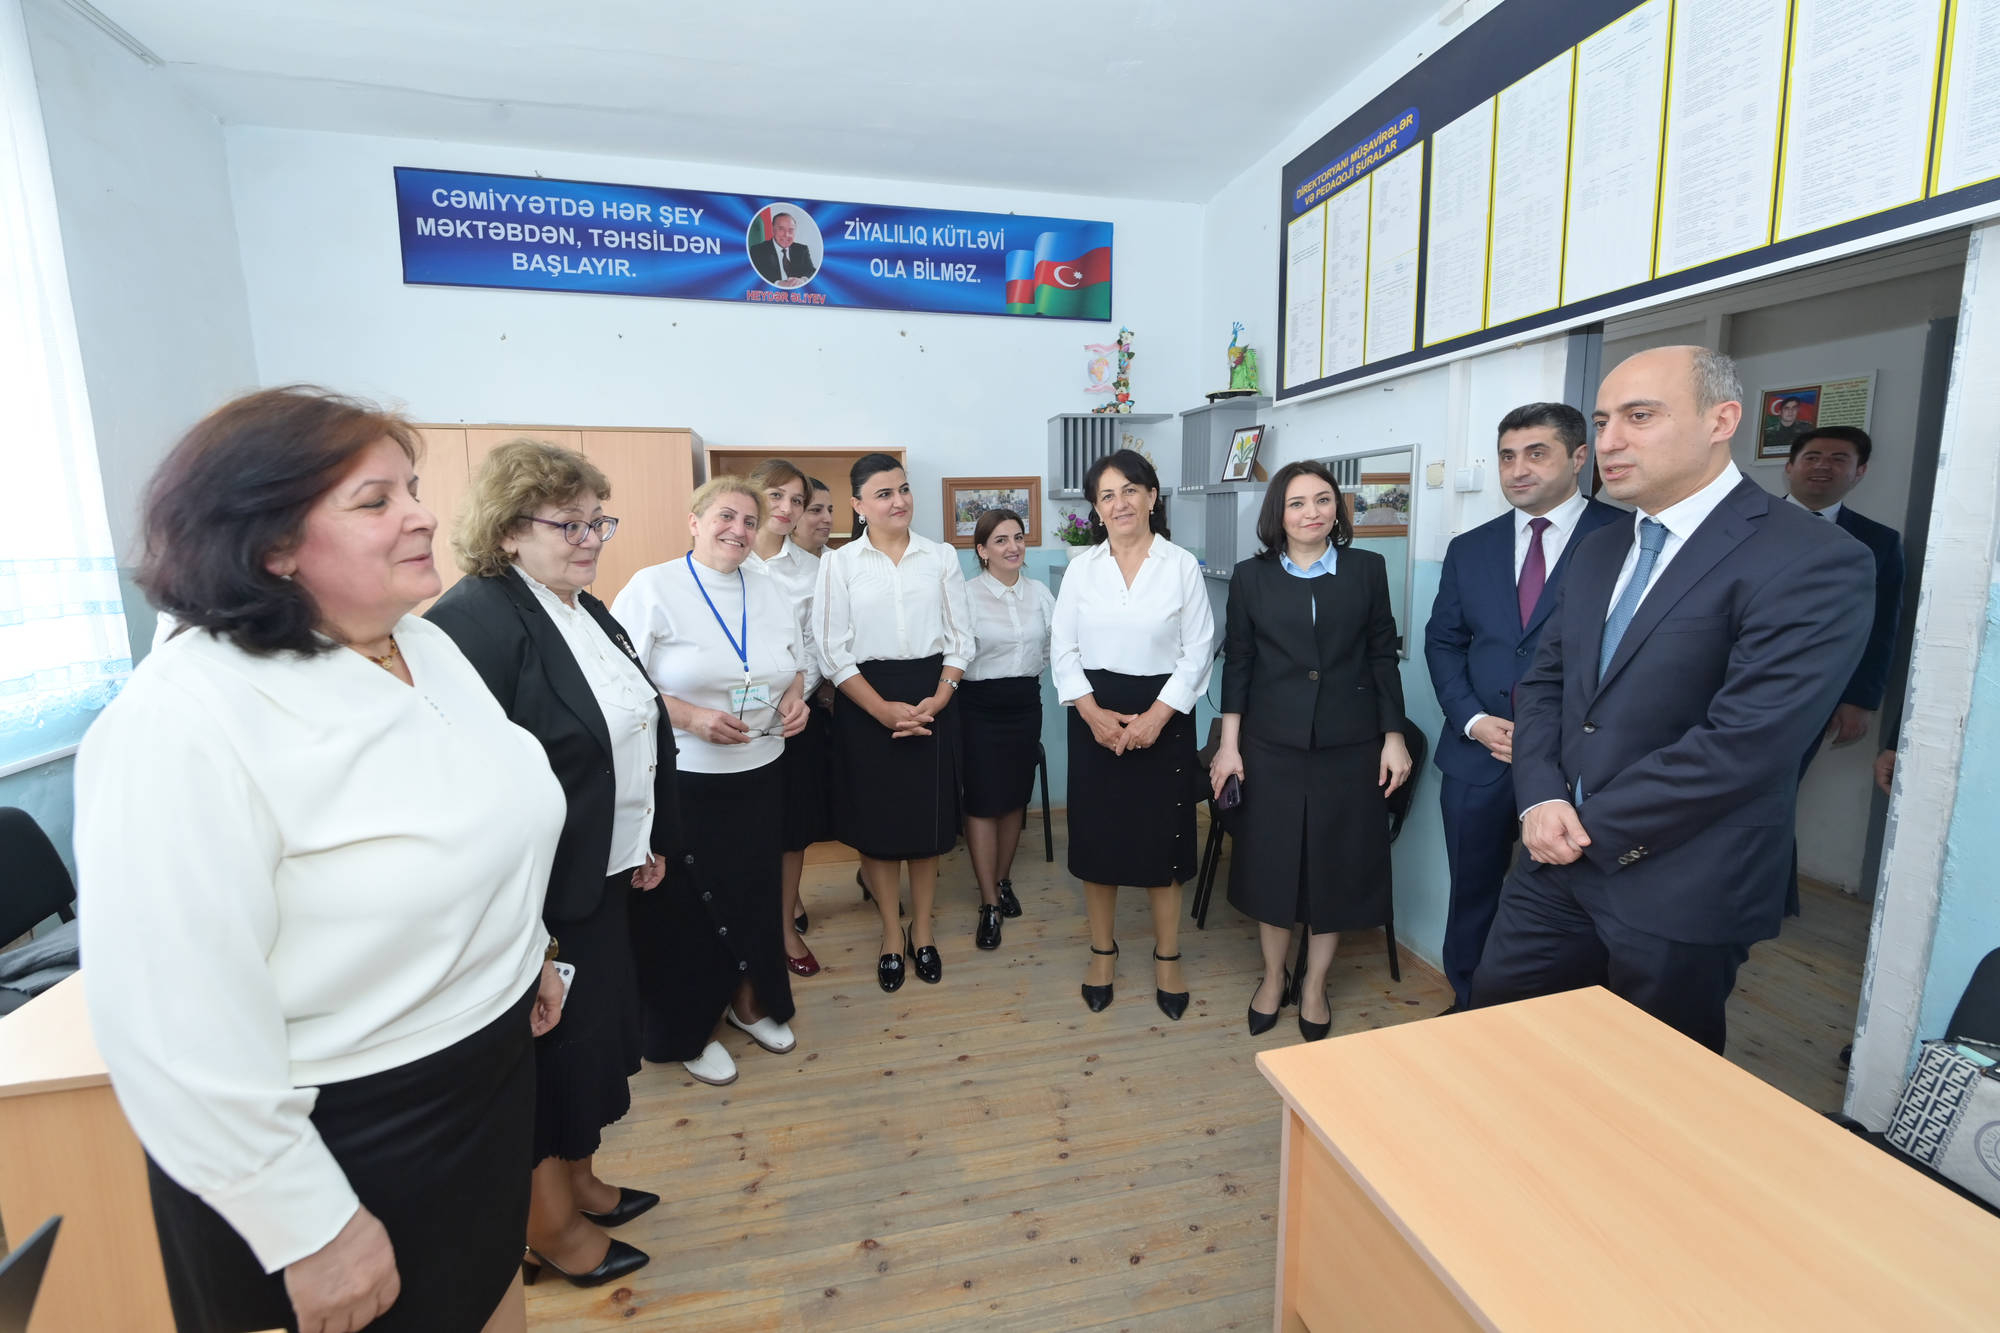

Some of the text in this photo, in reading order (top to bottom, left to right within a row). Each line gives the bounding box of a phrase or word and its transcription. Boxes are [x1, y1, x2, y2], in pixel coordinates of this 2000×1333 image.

[1304, 138, 1398, 206] VƏ PEDAQOJİ ŞURALAR
[432, 189, 704, 227] CƏMİYYƏTDƏ HƏR ŞEY
[416, 217, 721, 255] MƏKTƏBDƏN, TƏHSİLDƏN
[844, 220, 1005, 250] ZİYALILIQ KÜTLƏVİ
[512, 253, 637, 277] BAŞLAYIR.
[870, 257, 981, 283] OLA BİLMƏZ.
[746, 289, 789, 303] HEYDƏR
